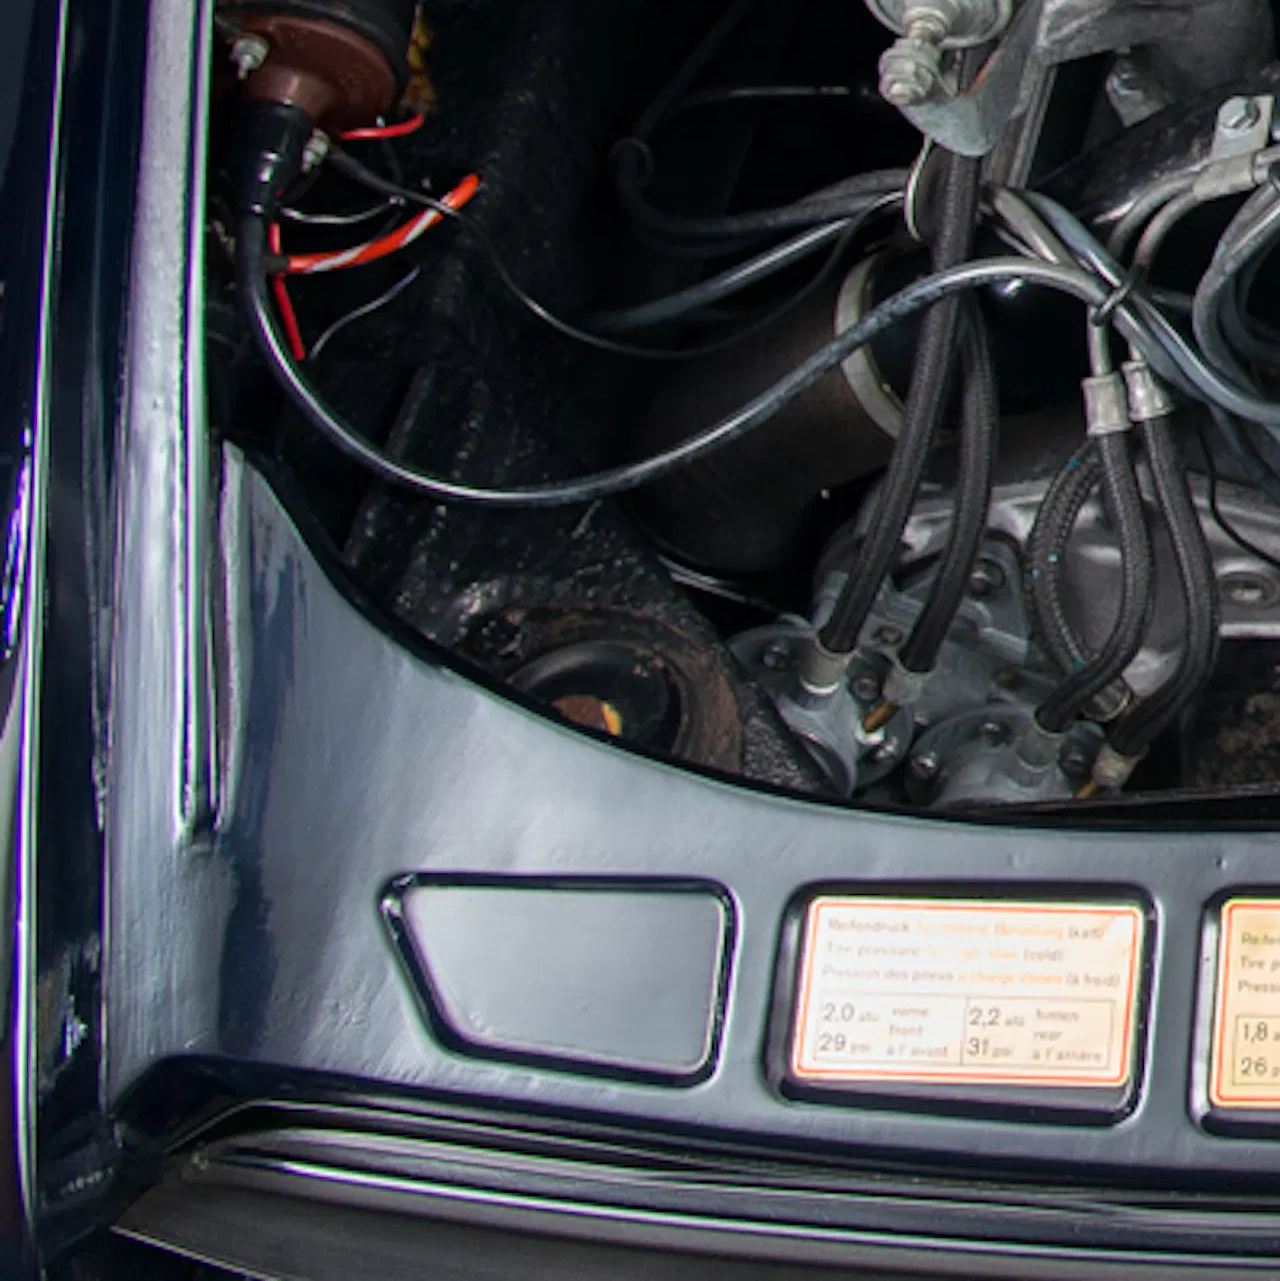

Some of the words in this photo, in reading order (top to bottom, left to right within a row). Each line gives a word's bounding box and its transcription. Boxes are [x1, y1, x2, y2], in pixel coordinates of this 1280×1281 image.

[968, 1005, 1001, 1028] 2,2
[818, 1031, 847, 1052] 29
[1243, 1021, 1269, 1046] 1,8
[966, 1035, 990, 1057] 31
[1240, 1056, 1268, 1078] 26
